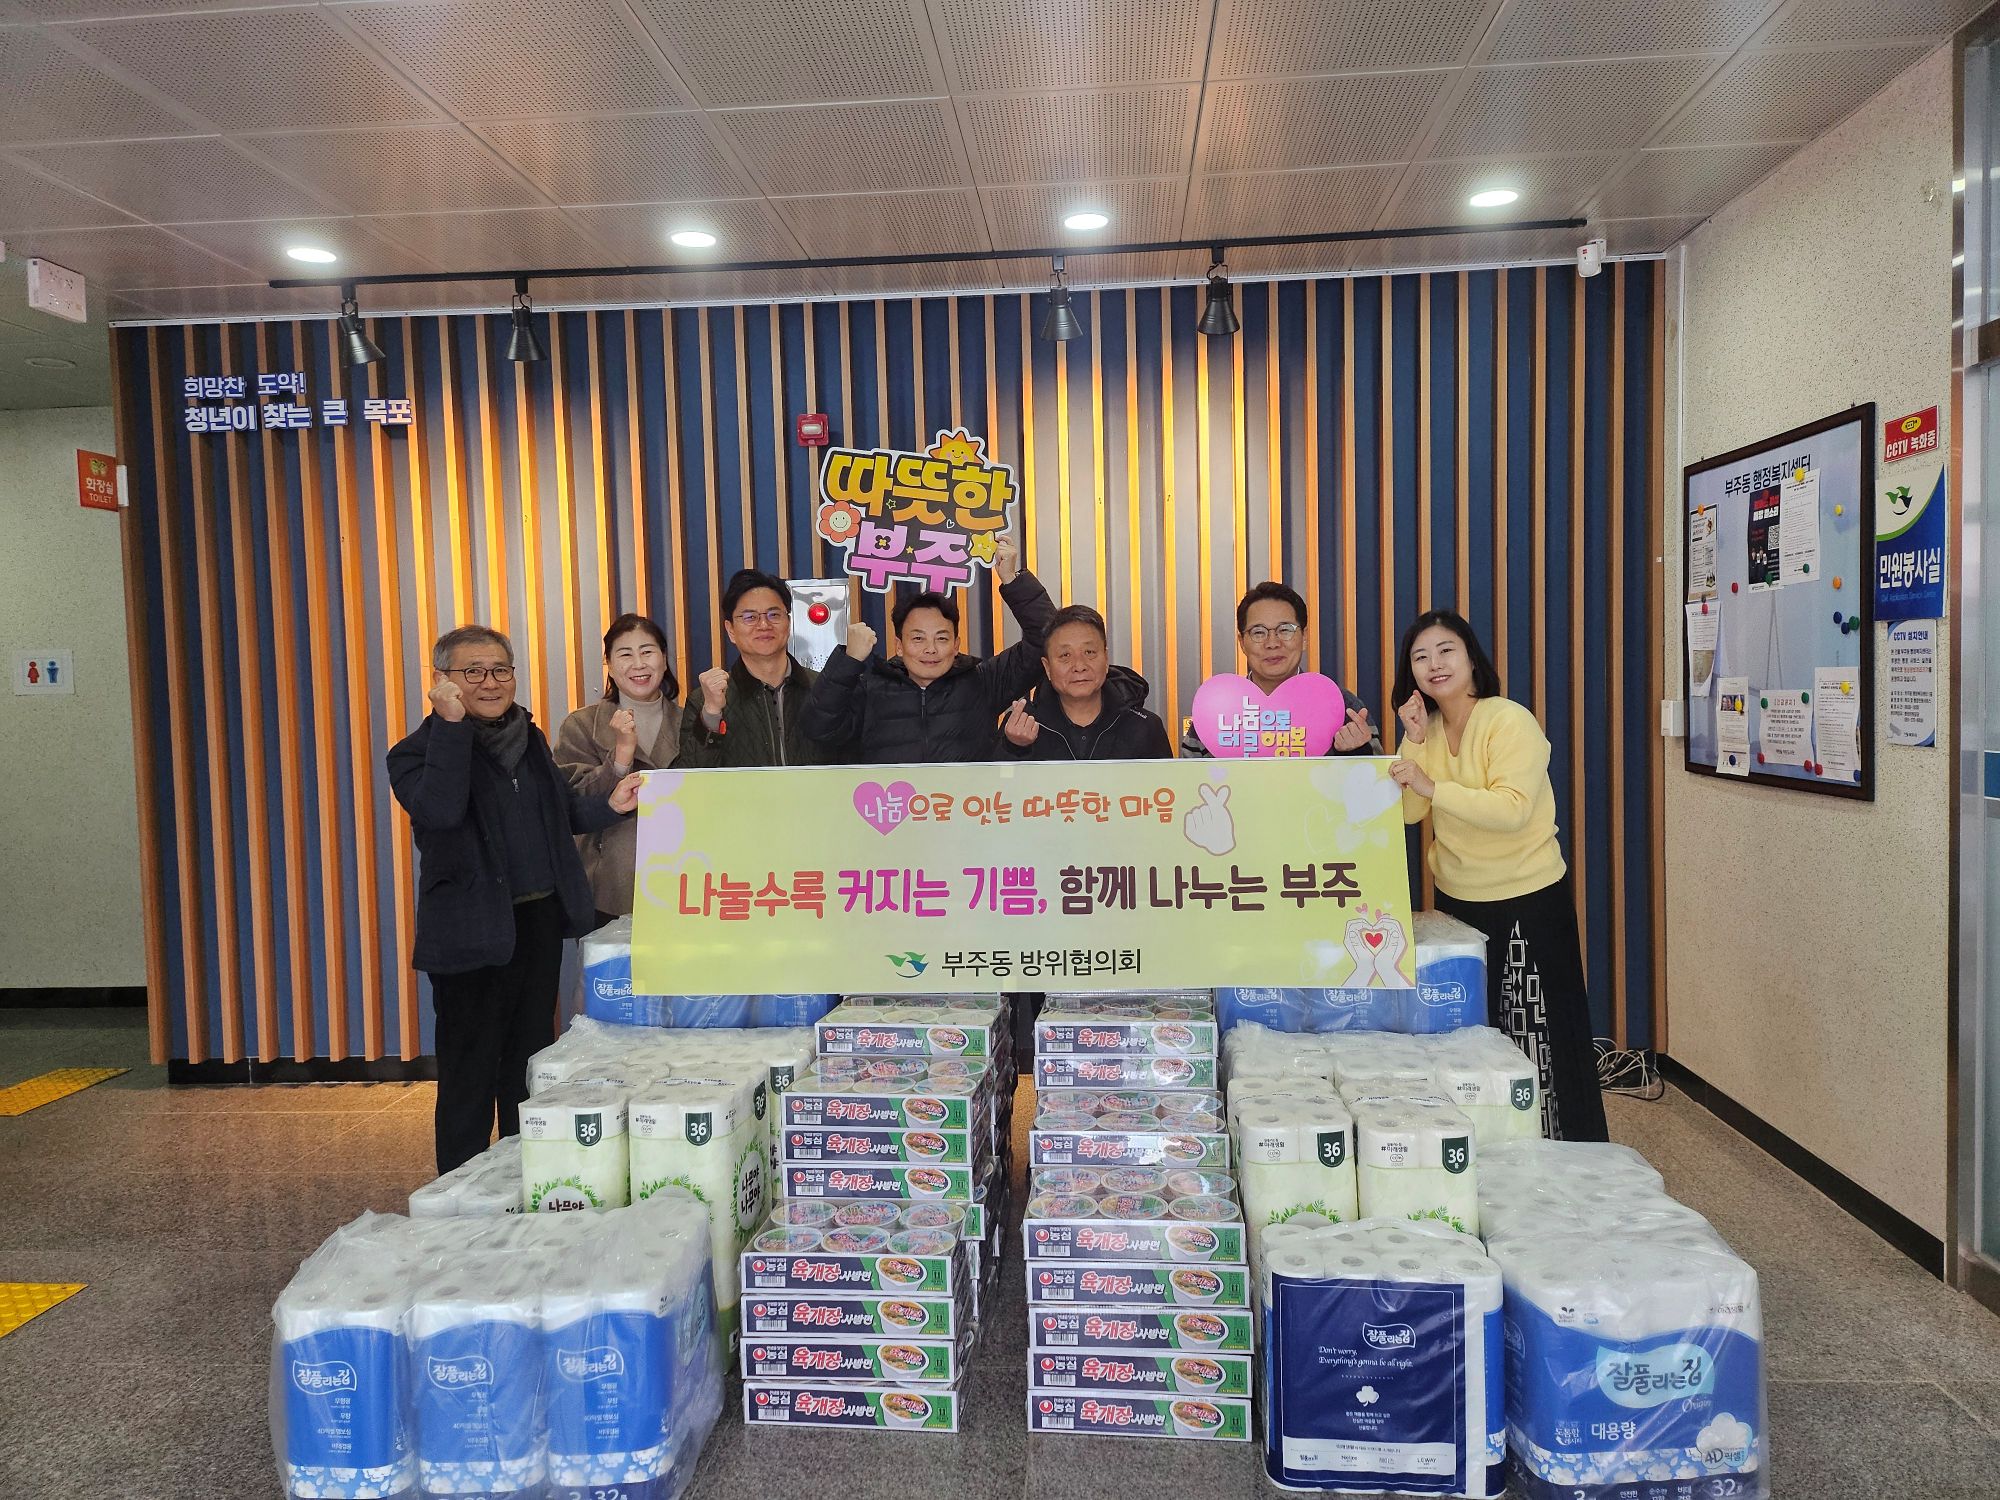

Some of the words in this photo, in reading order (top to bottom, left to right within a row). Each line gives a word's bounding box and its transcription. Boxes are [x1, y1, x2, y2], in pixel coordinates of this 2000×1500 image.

[184, 377, 246, 398] 희망찬
[257, 373, 305, 394] 도약!
[184, 405, 256, 431] 청년이
[263, 403, 311, 428] 찾는
[322, 400, 346, 425] 큰
[363, 399, 412, 424] 목포
[1886, 438, 1908, 459] CCTV
[1910, 429, 1936, 450] 녹화중
[1725, 473, 1751, 498] 부주동
[1753, 453, 1811, 490] 행정복지센터
[86, 477, 114, 495] 화장실
[828, 454, 1013, 531] 따뜻한
[89, 493, 113, 503] TOILET
[851, 520, 969, 594] 부주
[1880, 547, 1940, 589] 민원봉사실
[1893, 631, 1906, 641] CCTV
[1907, 630, 1929, 641] 설치안내
[1218, 695, 1291, 731] 나눔으로
[1218, 732, 1240, 747] 더
[1261, 726, 1306, 757] 행복
[864, 792, 954, 824] 나눔으로
[963, 791, 1013, 825] 잇는
[1022, 789, 1111, 823] 따뜻한
[1119, 787, 1176, 823] 마음
[679, 870, 827, 920] 나눌수록
[838, 868, 950, 917] 커지는
[962, 866, 1048, 915] 기쁨,
[1059, 865, 1137, 915] 함께
[1149, 864, 1268, 911] 나누는
[1280, 862, 1362, 909] 부주
[942, 951, 1013, 978] 부주동
[1020, 948, 1141, 977] 방위협의회
[1421, 987, 1461, 1001] 잘풀리는집
[836, 1031, 853, 1040] 농심
[857, 1029, 898, 1048] 육개장
[1056, 1030, 1074, 1040] 농심
[1077, 1028, 1120, 1048] 육개장
[1056, 1063, 1074, 1073] 농심
[1077, 1061, 1120, 1081] 육개장
[775, 1075, 790, 1087] 36
[755, 1092, 765, 1109] 36
[1515, 1088, 1531, 1102] 36
[803, 1101, 823, 1111] 농심
[826, 1099, 871, 1121] 육개장
[580, 1123, 596, 1137] 36
[690, 1122, 707, 1136] 36
[803, 1136, 823, 1146] 농심
[826, 1134, 871, 1155] 육개장
[1053, 1139, 1073, 1149] 농심
[1077, 1138, 1124, 1159] 육개장
[1323, 1141, 1341, 1157] 36
[1448, 1147, 1465, 1163] 36
[805, 1173, 825, 1183] 농심
[829, 1171, 873, 1192] 육개장
[1049, 1230, 1072, 1241] 농심
[1076, 1228, 1128, 1252] 육개장
[766, 1261, 787, 1272] 농심
[792, 1258, 841, 1282] 육개장
[1053, 1273, 1076, 1284] 농심
[1080, 1271, 1132, 1295] 육개장
[767, 1306, 788, 1316] 농심
[793, 1302, 842, 1326] 육개장
[1058, 1319, 1079, 1329] 농심
[1084, 1316, 1137, 1341] 육개장
[1366, 1329, 1410, 1345] 잘풀리는집
[767, 1349, 788, 1360] 농심
[792, 1347, 842, 1371] 육개장
[1318, 1345, 1337, 1355] Don't
[1338, 1348, 1358, 1357] worry,
[562, 1354, 617, 1376] 잘풀리는집
[1055, 1360, 1077, 1371] 농심
[1082, 1357, 1135, 1383] 육개장
[1318, 1356, 1357, 1367] Everything's
[1357, 1359, 1378, 1368] gonna
[1379, 1357, 1387, 1366] be
[297, 1368, 351, 1388] 잘풀리는집
[433, 1362, 487, 1383] 잘풀리는집
[1606, 1356, 1702, 1396] 잘풀리는집
[770, 1394, 790, 1405] 농심
[795, 1392, 845, 1417] 육개장
[1054, 1402, 1076, 1413] 농심
[1080, 1400, 1133, 1425] 육개장
[1591, 1421, 1636, 1441] 대용량
[1711, 1478, 1736, 1497] 32
